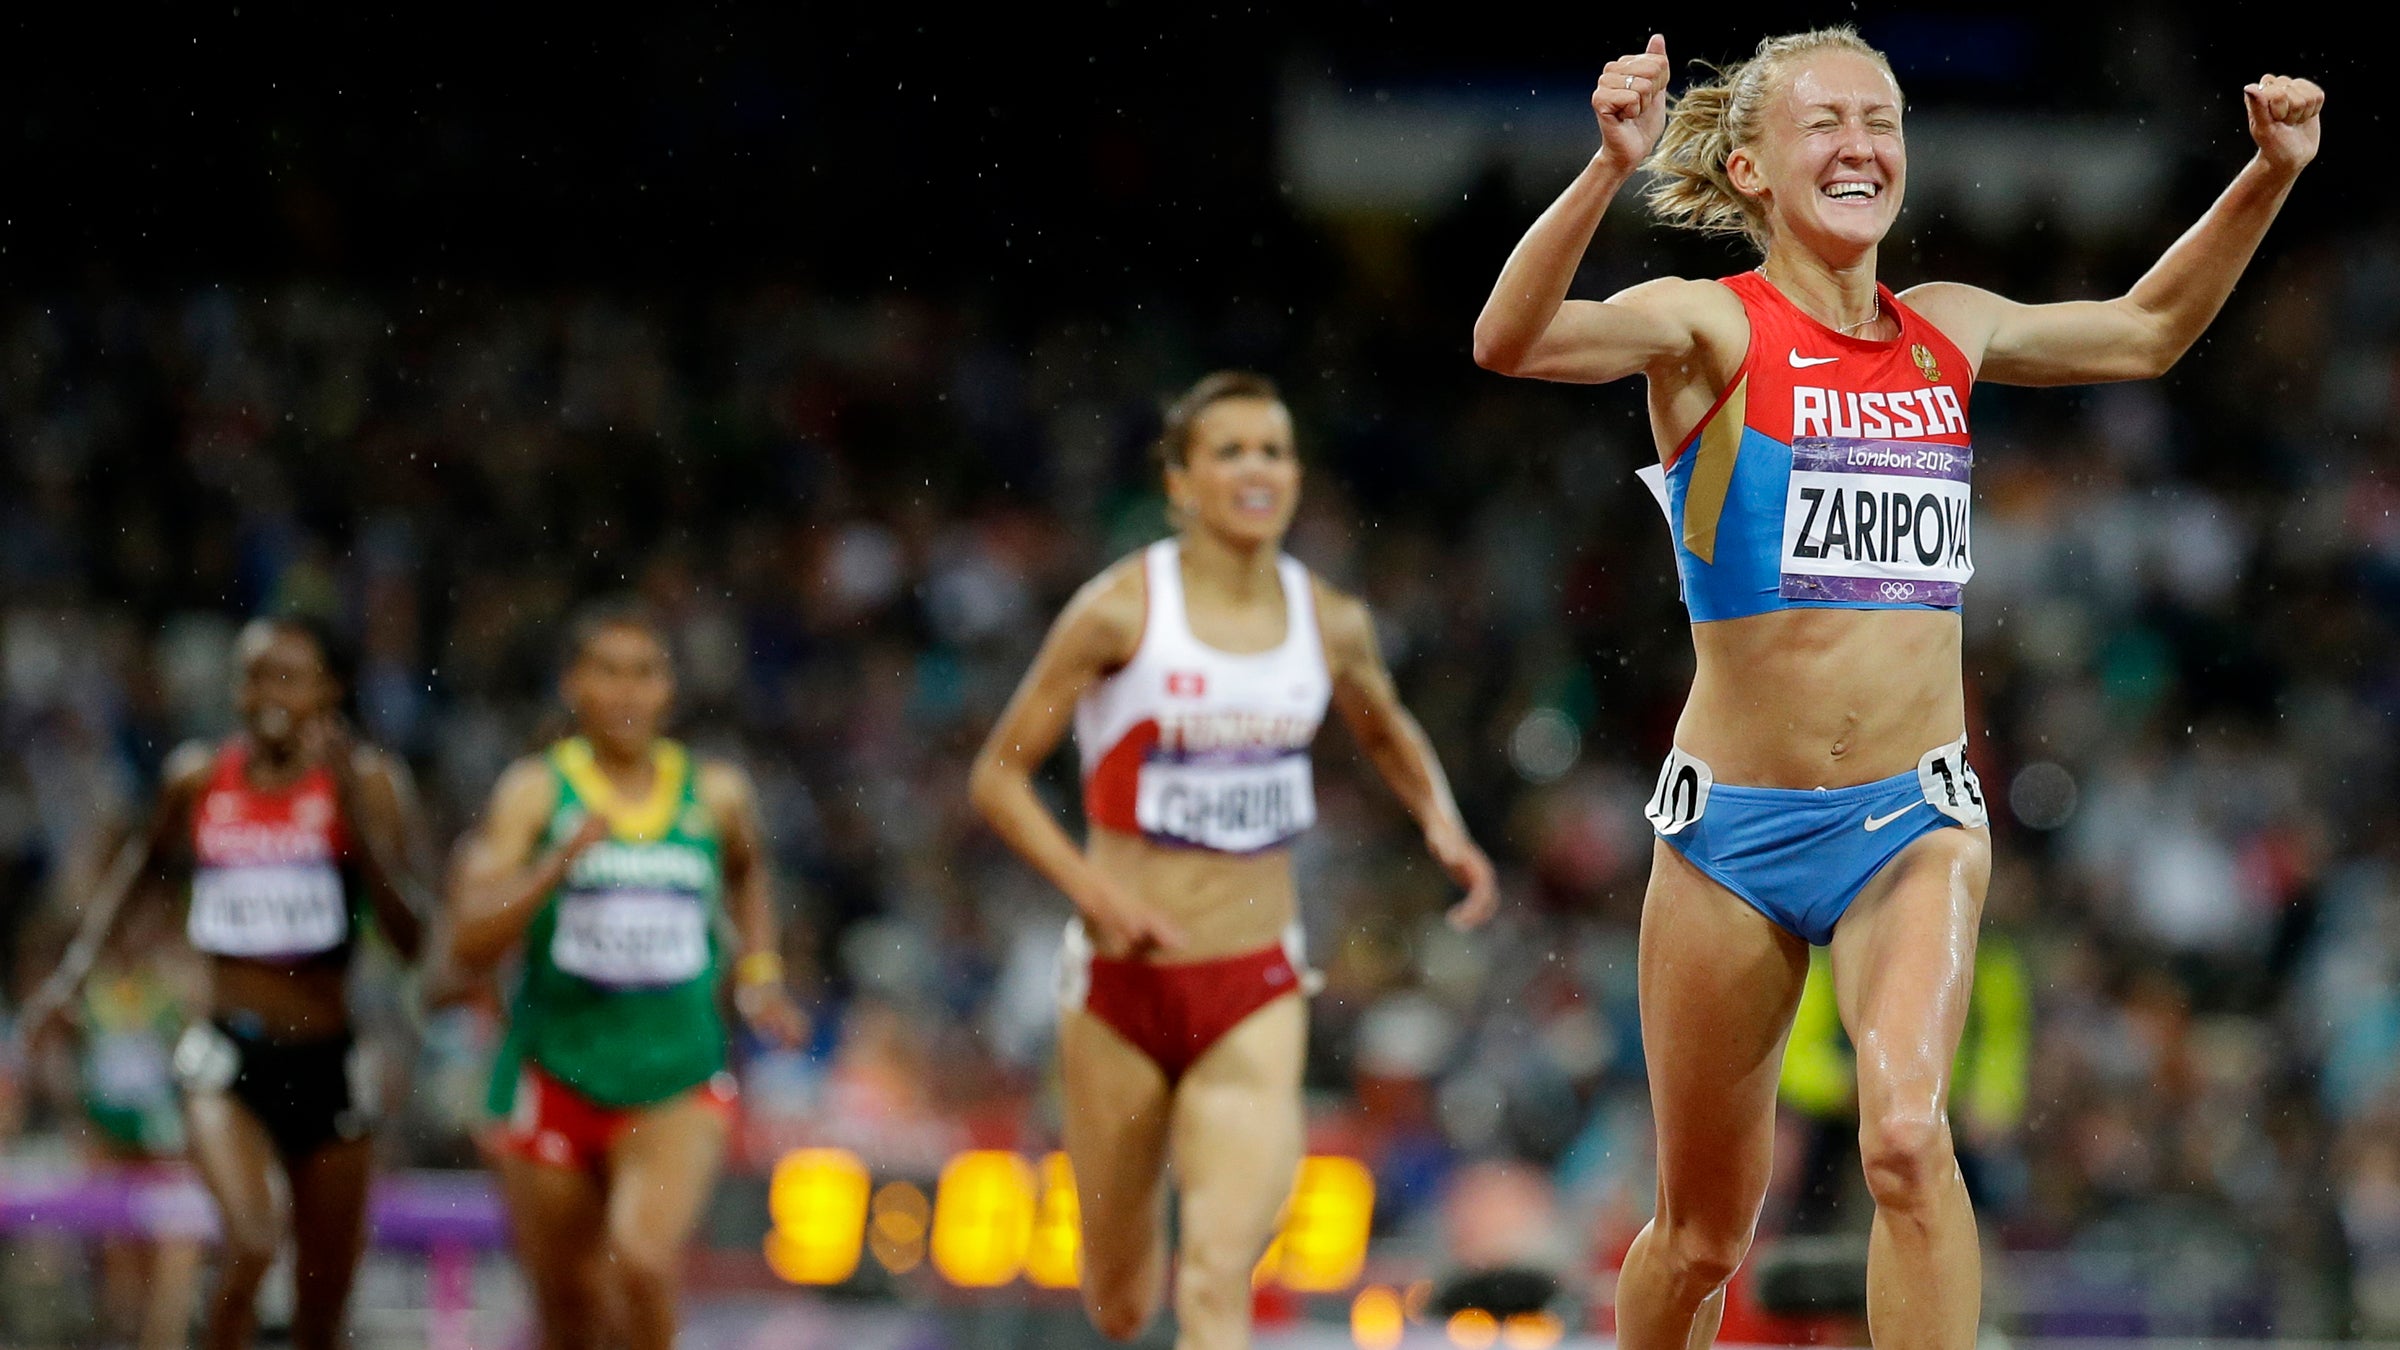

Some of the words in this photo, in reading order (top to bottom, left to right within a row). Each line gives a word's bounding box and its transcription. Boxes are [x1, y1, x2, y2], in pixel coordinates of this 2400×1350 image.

[1793, 386, 1967, 438] RUSSIA
[1847, 447, 1912, 469] London
[1917, 450, 1953, 472] 2012
[1793, 487, 1971, 568] ZARIPOVA
